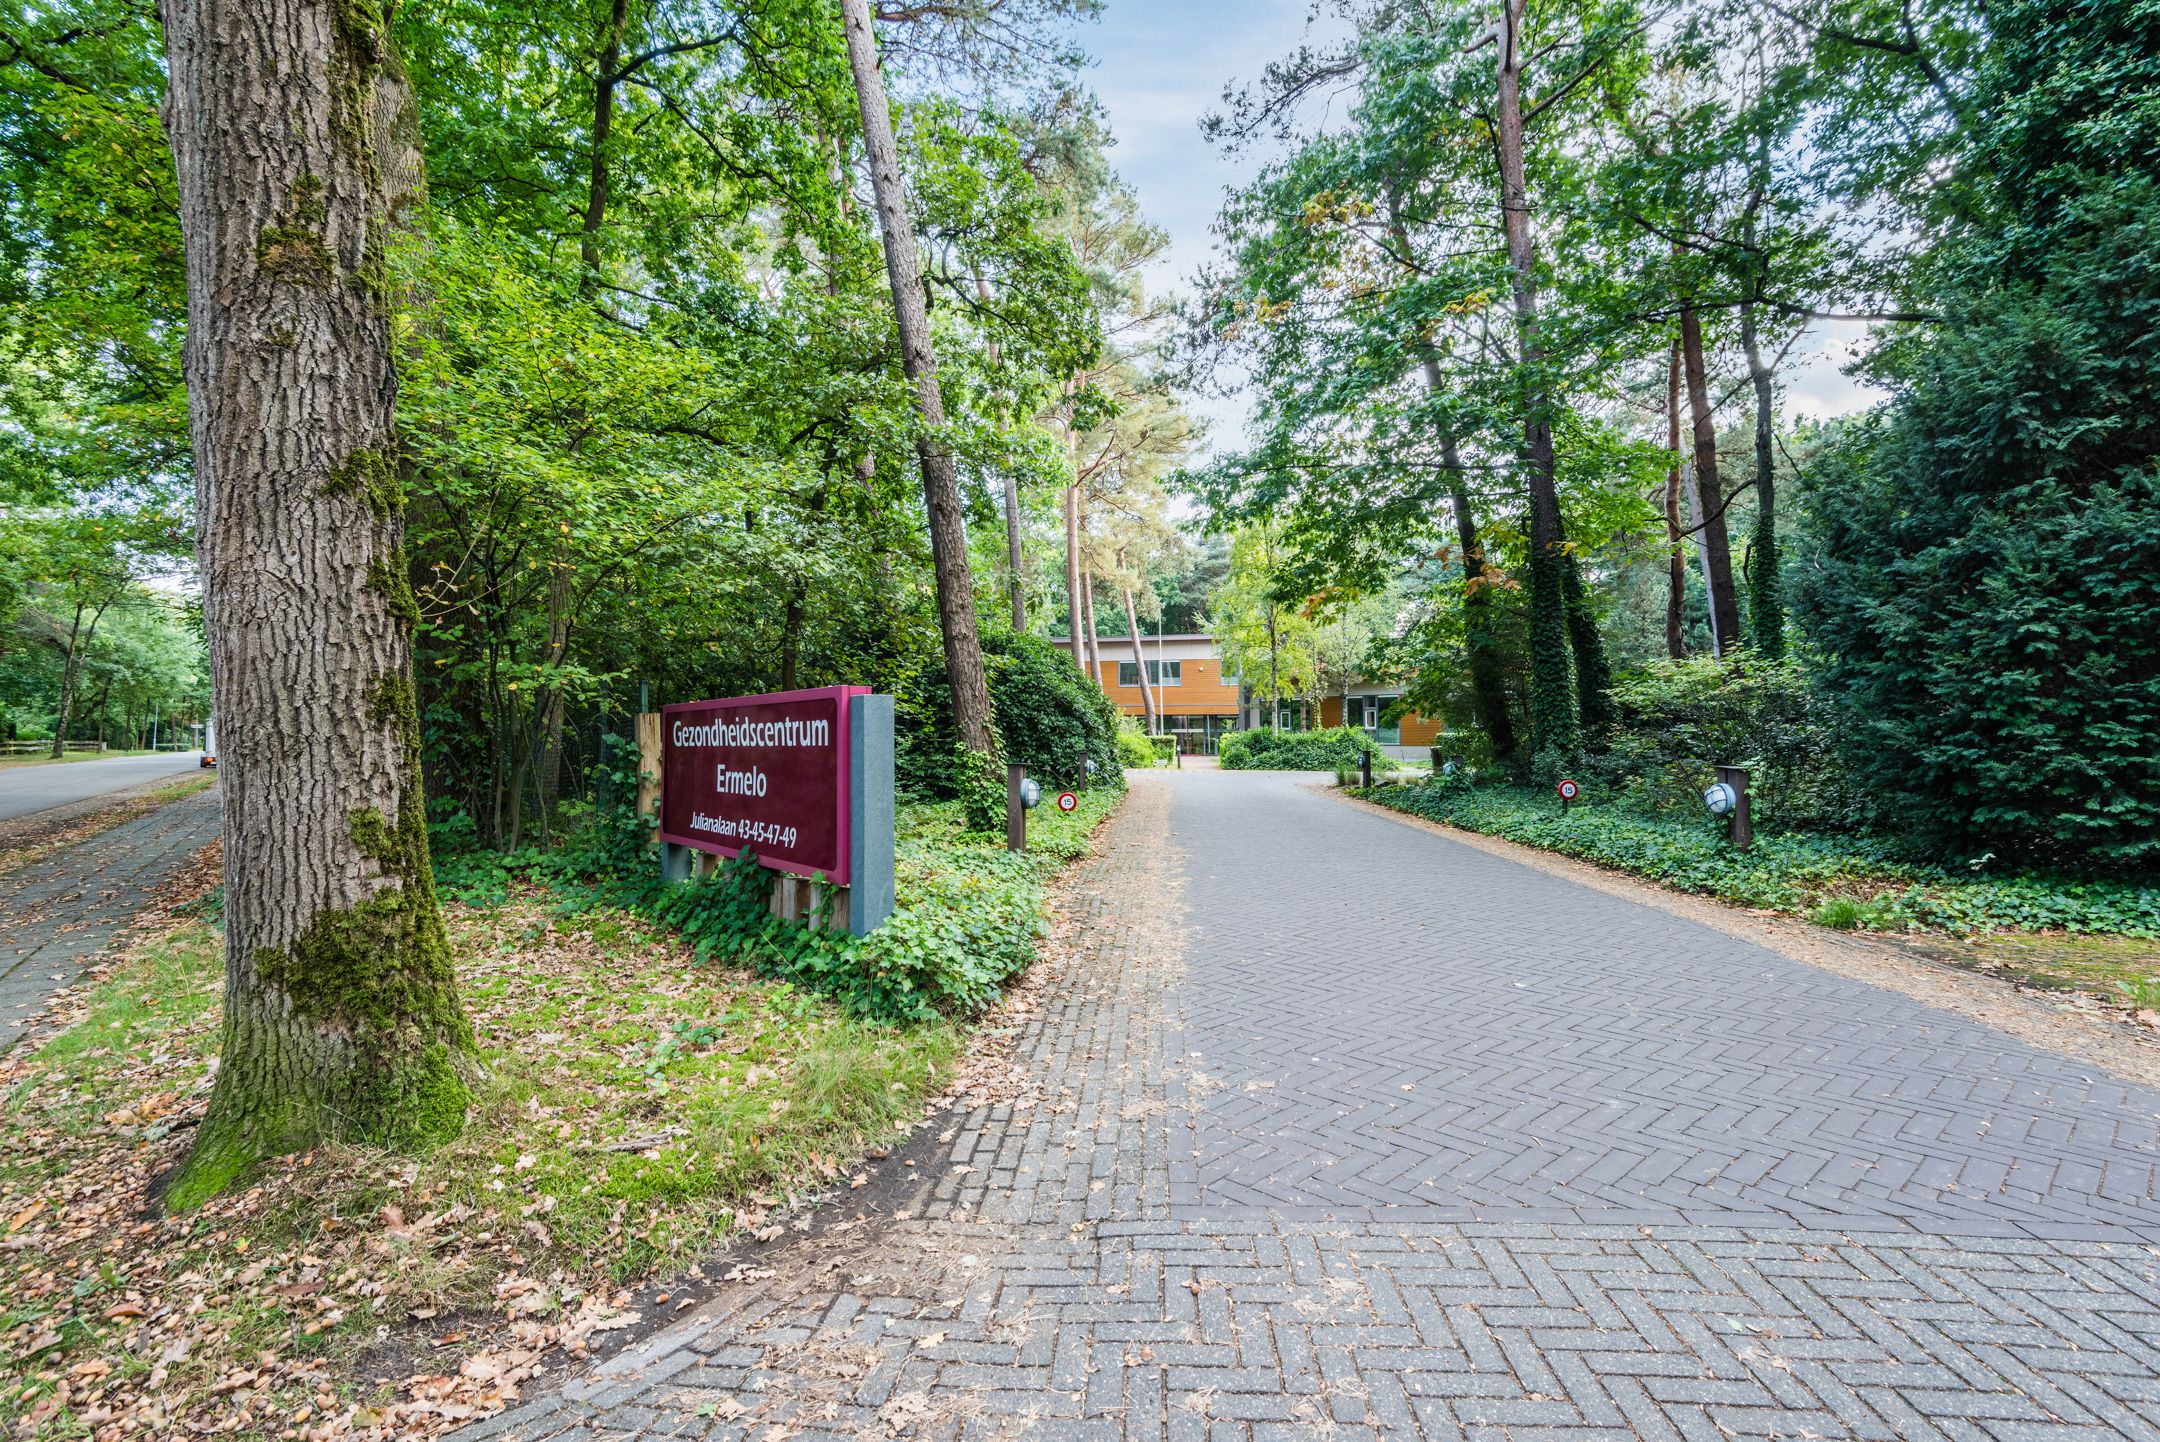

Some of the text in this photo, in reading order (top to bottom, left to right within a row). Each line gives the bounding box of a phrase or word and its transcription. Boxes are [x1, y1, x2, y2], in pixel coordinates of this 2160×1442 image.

[673, 717, 829, 747] Gezondheidscentrum
[716, 764, 767, 797] Ermelo
[690, 811, 797, 848] Julianalaan 43-45-47-49
